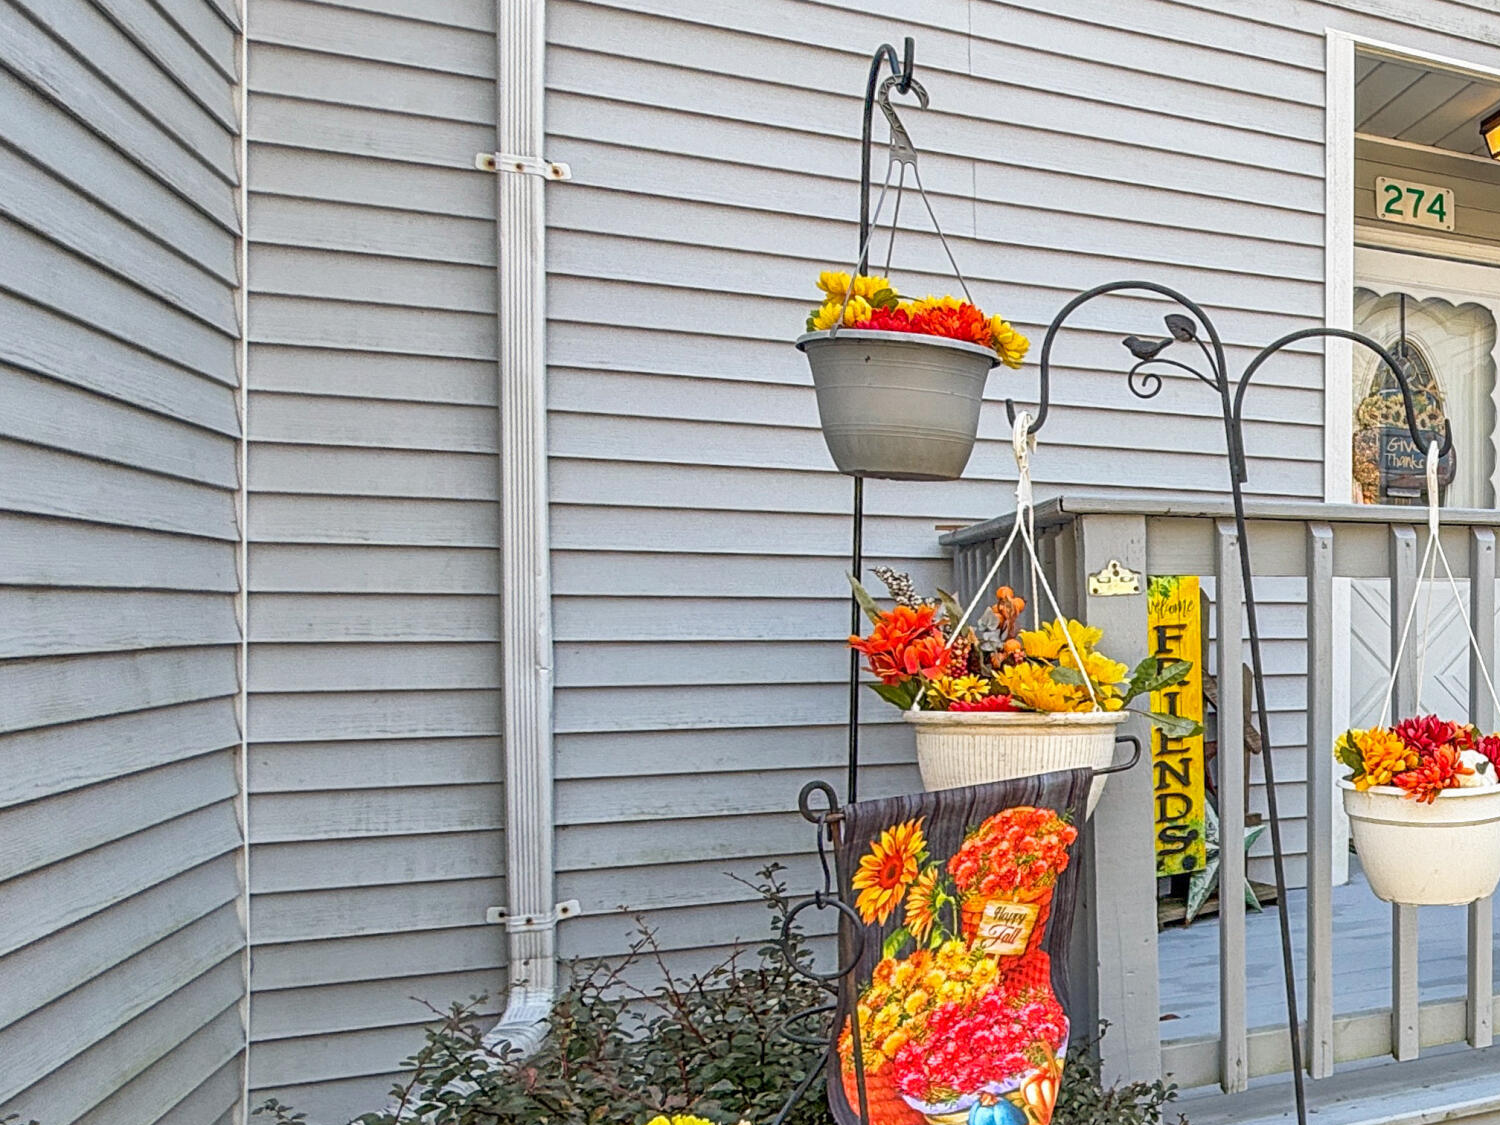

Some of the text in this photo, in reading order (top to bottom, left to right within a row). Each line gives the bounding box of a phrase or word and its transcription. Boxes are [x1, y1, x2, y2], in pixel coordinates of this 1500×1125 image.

[1384, 184, 1447, 223] 274
[993, 905, 1027, 926] Happy
[979, 923, 1023, 950] Fall
